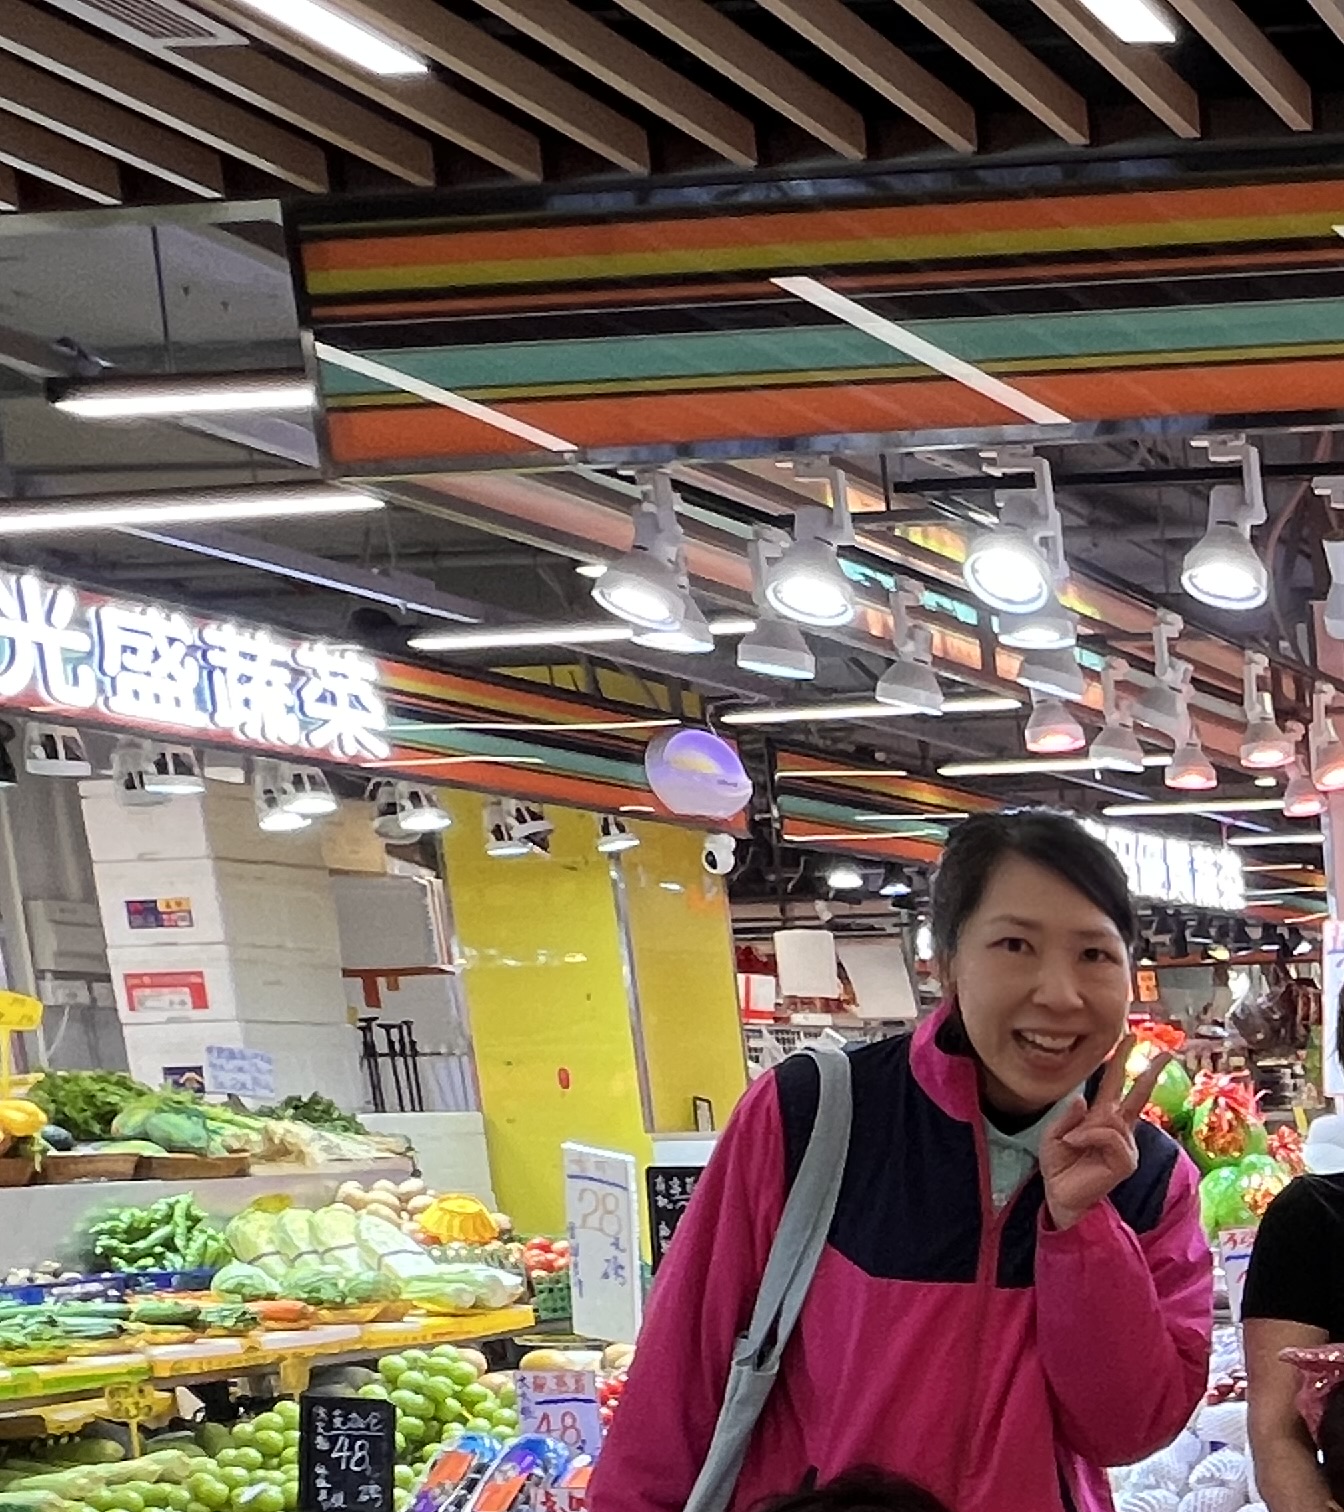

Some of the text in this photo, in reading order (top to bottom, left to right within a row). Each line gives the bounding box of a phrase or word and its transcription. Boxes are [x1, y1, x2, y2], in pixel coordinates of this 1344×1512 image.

[577, 1187, 622, 1238] 28
[535, 1410, 582, 1447] 48
[331, 1435, 371, 1473] 48
